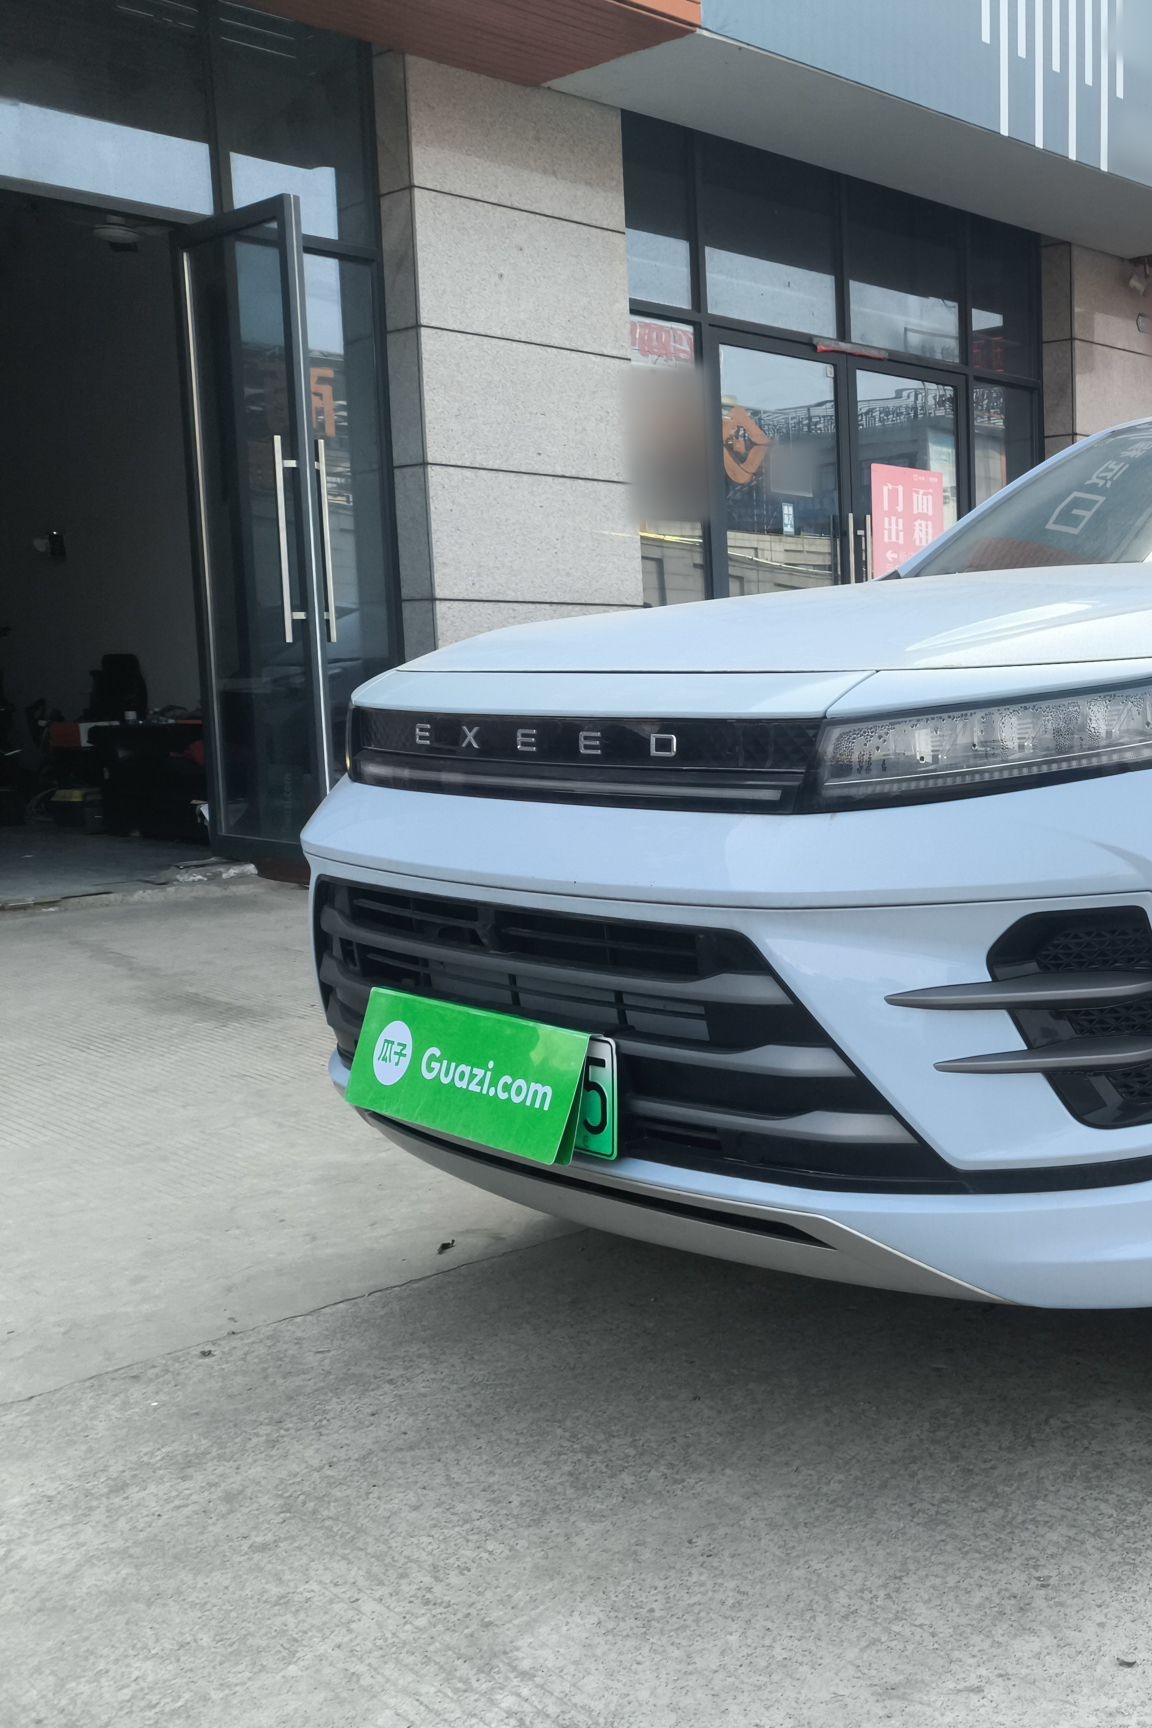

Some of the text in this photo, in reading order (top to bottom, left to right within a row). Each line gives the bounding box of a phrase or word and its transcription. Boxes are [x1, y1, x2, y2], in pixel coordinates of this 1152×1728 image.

[882, 482, 934, 517] 门面
[883, 515, 934, 547] 出租
[415, 723, 677, 757] EXEED
[377, 1038, 407, 1067] 瓜子
[420, 1046, 553, 1111] Guazi.com
[583, 1056, 608, 1135] 5
